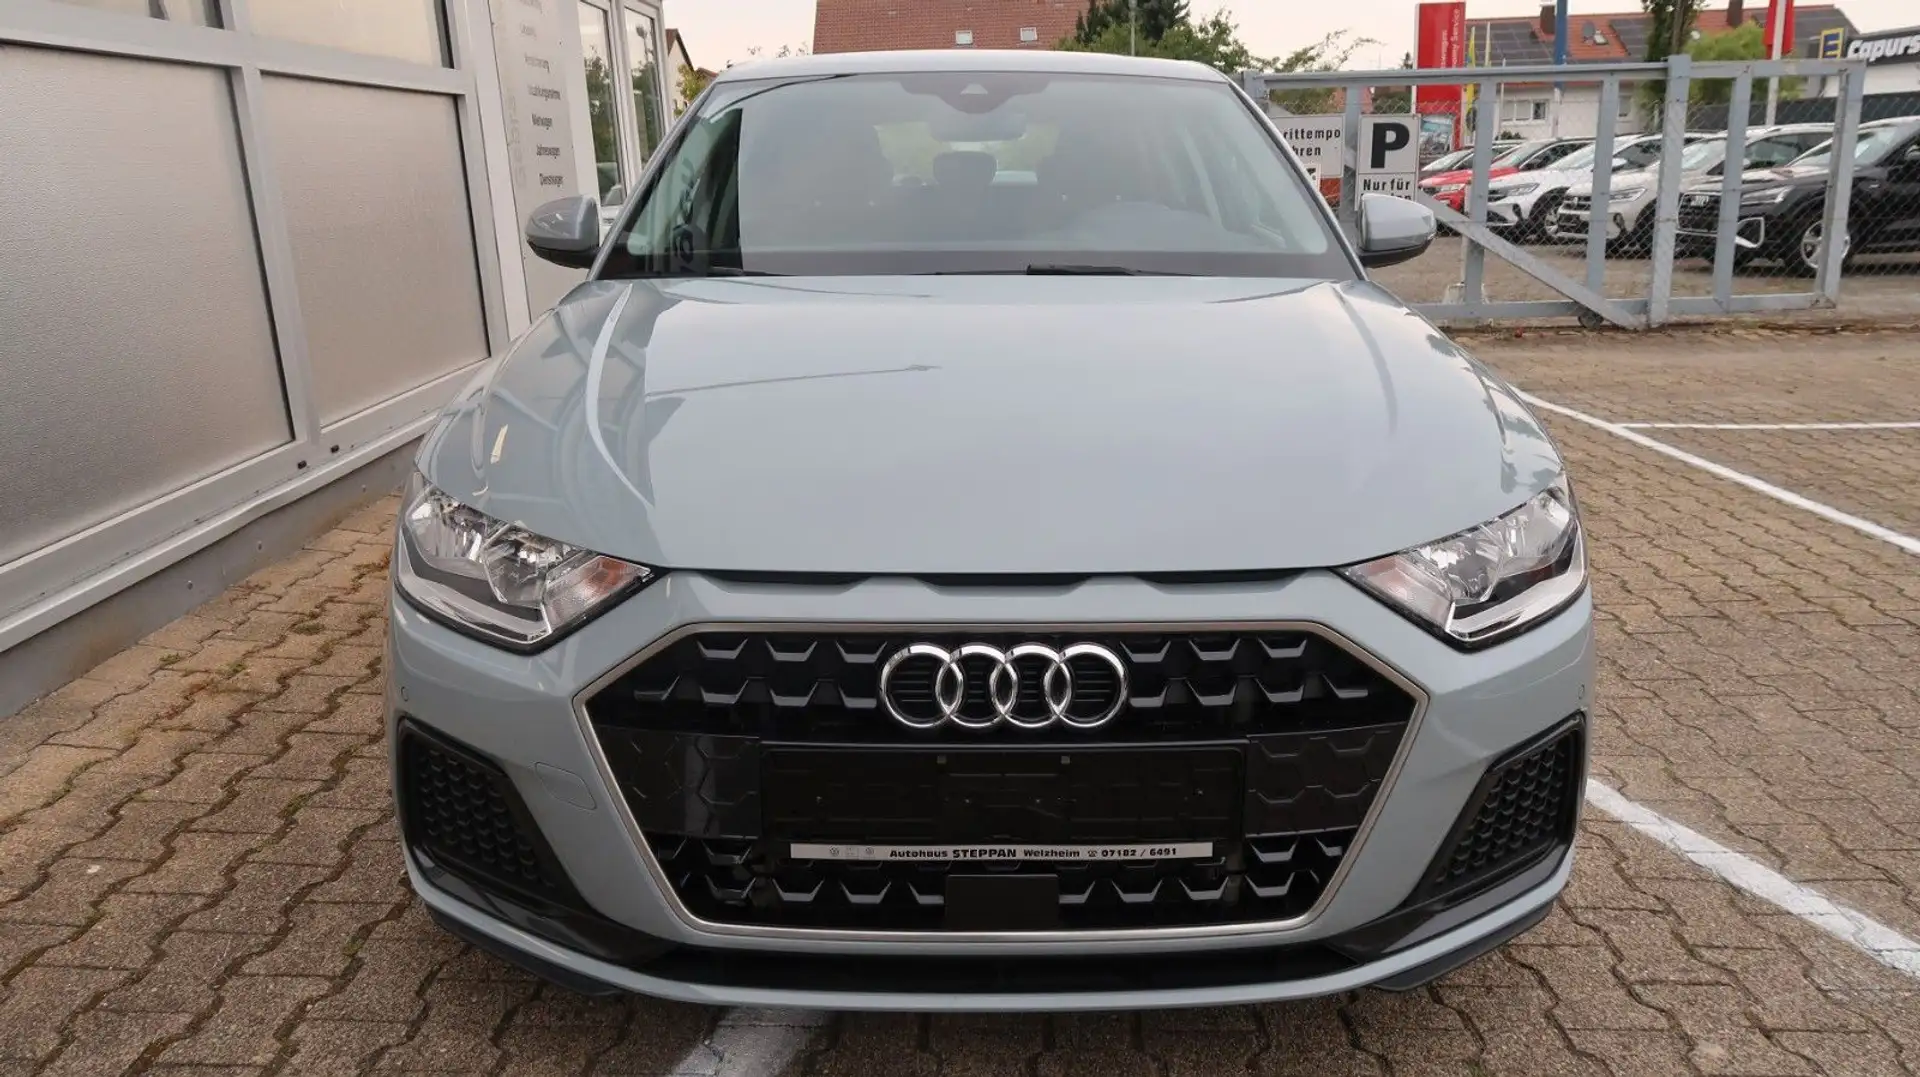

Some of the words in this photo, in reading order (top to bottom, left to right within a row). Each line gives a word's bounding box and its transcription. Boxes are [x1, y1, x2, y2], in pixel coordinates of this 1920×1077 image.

[1283, 128, 1341, 141] rittempo
[1292, 145, 1321, 156] hren
[1371, 122, 1410, 169] P
[1363, 179, 1386, 191] Nur
[1390, 178, 1410, 191] für
[890, 849, 948, 858] Autohaus
[952, 849, 1016, 858] STEPPAN
[1023, 849, 1080, 858] Welzheim
[1101, 849, 1137, 857] 07182
[1149, 848, 1177, 857] 6491
